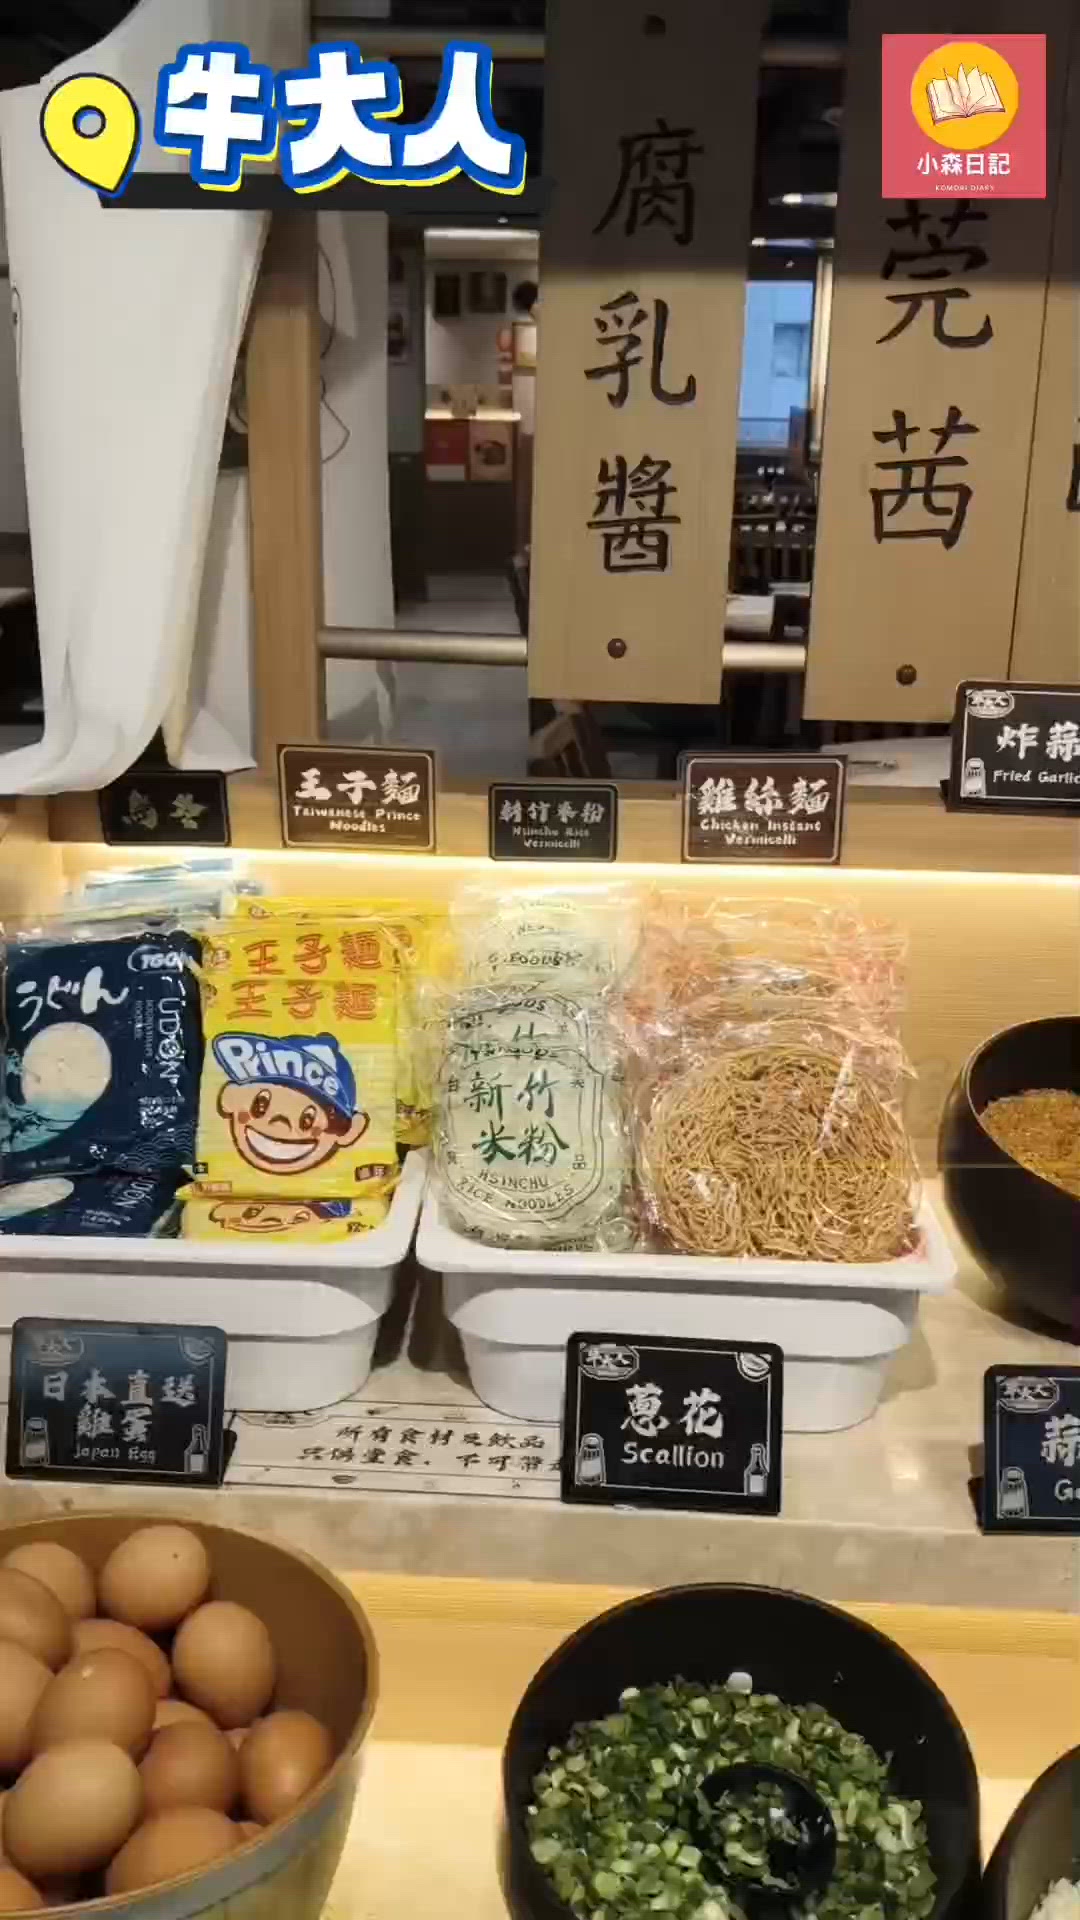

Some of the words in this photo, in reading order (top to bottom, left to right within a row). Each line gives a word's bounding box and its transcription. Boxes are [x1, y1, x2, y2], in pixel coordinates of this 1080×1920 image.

[583, 116, 705, 574] 腐乳醬
[295, 767, 421, 806] 王子麵
[993, 769, 1033, 783] Fried
[293, 805, 366, 819] Taiwanese
[375, 808, 421, 822] Prince
[329, 821, 387, 833] Noodles
[700, 817, 760, 832] Chicken
[767, 819, 822, 833] Instant
[725, 833, 798, 846] Vermicelli
[242, 931, 383, 975] 王子麵
[226, 979, 378, 1021] 王子麵
[157, 998, 187, 1086] UDON
[217, 1037, 339, 1097] Prince
[463, 1068, 561, 1121] 新竹
[471, 1119, 570, 1167] 米粉
[478, 1168, 550, 1190] HSINCHU
[42, 1368, 196, 1408] 日本直送
[74, 1443, 120, 1461] Japan
[128, 1445, 157, 1465] Egg
[620, 1441, 725, 1470] Scallion
